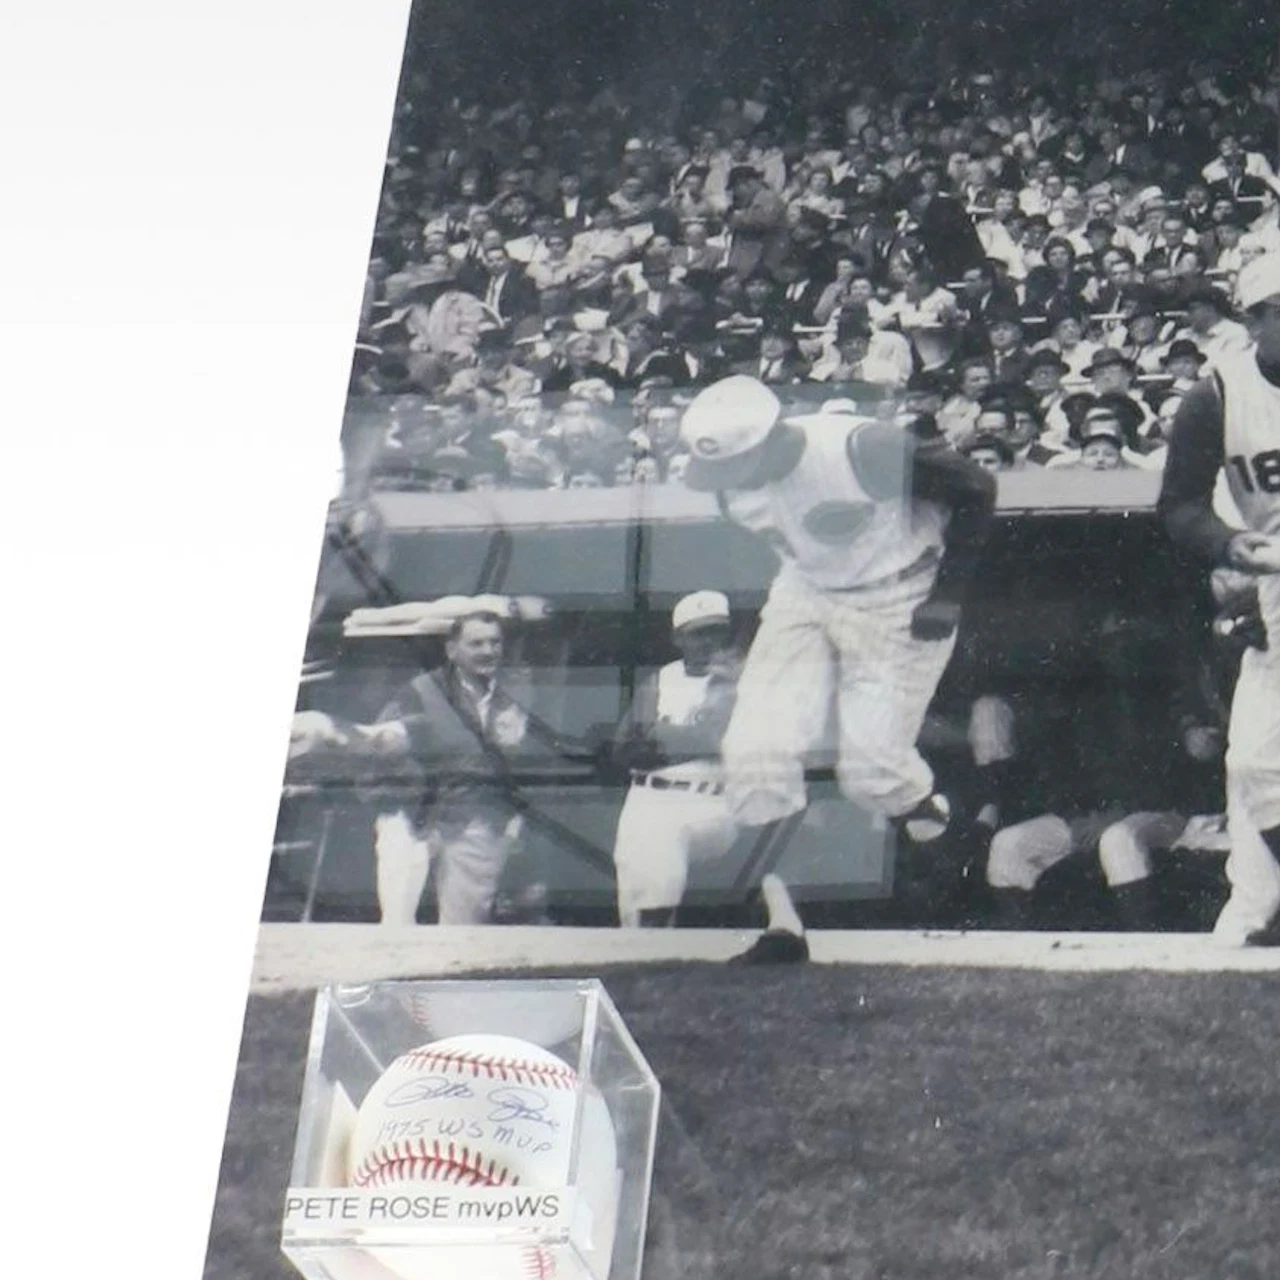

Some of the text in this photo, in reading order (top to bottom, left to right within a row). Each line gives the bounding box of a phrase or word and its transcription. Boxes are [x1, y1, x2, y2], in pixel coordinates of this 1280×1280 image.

[286, 1194, 559, 1221] PETE ROSE mvpWS
